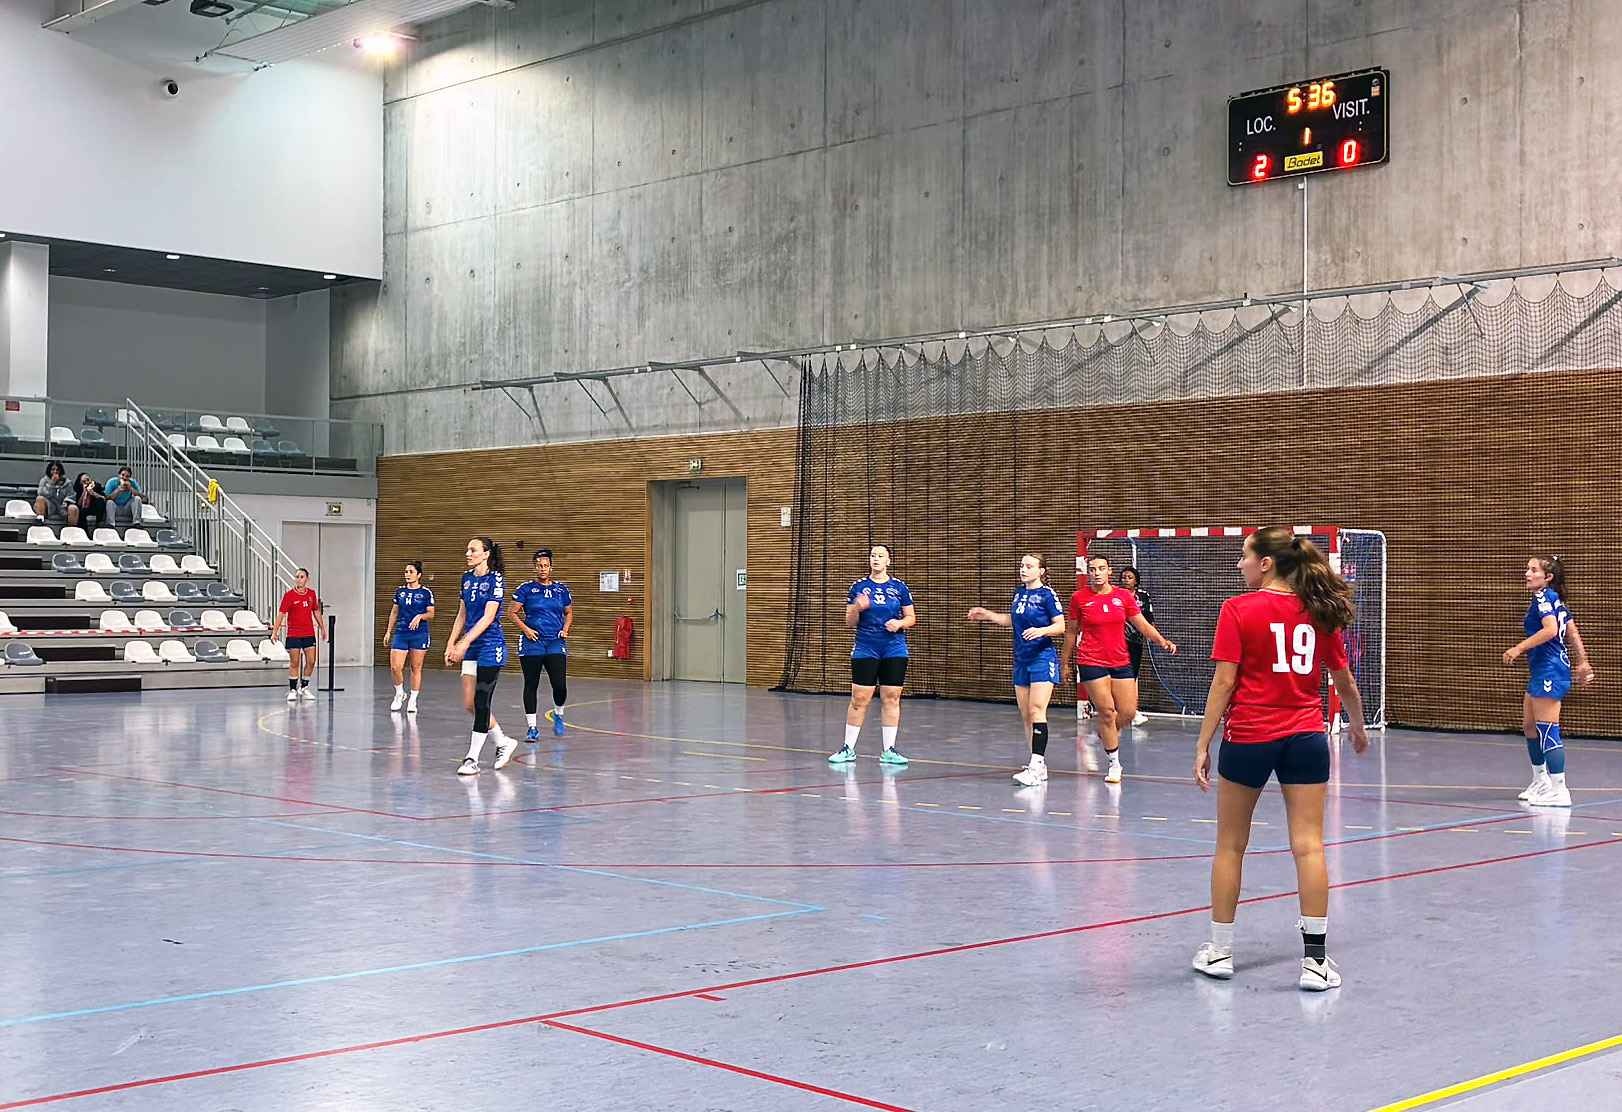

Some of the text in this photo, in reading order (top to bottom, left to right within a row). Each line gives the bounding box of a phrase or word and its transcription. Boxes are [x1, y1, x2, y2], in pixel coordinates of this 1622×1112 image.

[1332, 98, 1370, 120] VISIT.
[1246, 115, 1276, 135] LOC.
[1304, 127, 1311, 146] 1
[1288, 155, 1321, 168] Bodet
[1343, 140, 1357, 163] 0
[1254, 155, 1268, 177] 2
[470, 590, 477, 602] 5
[1269, 622, 1316, 675] 19
